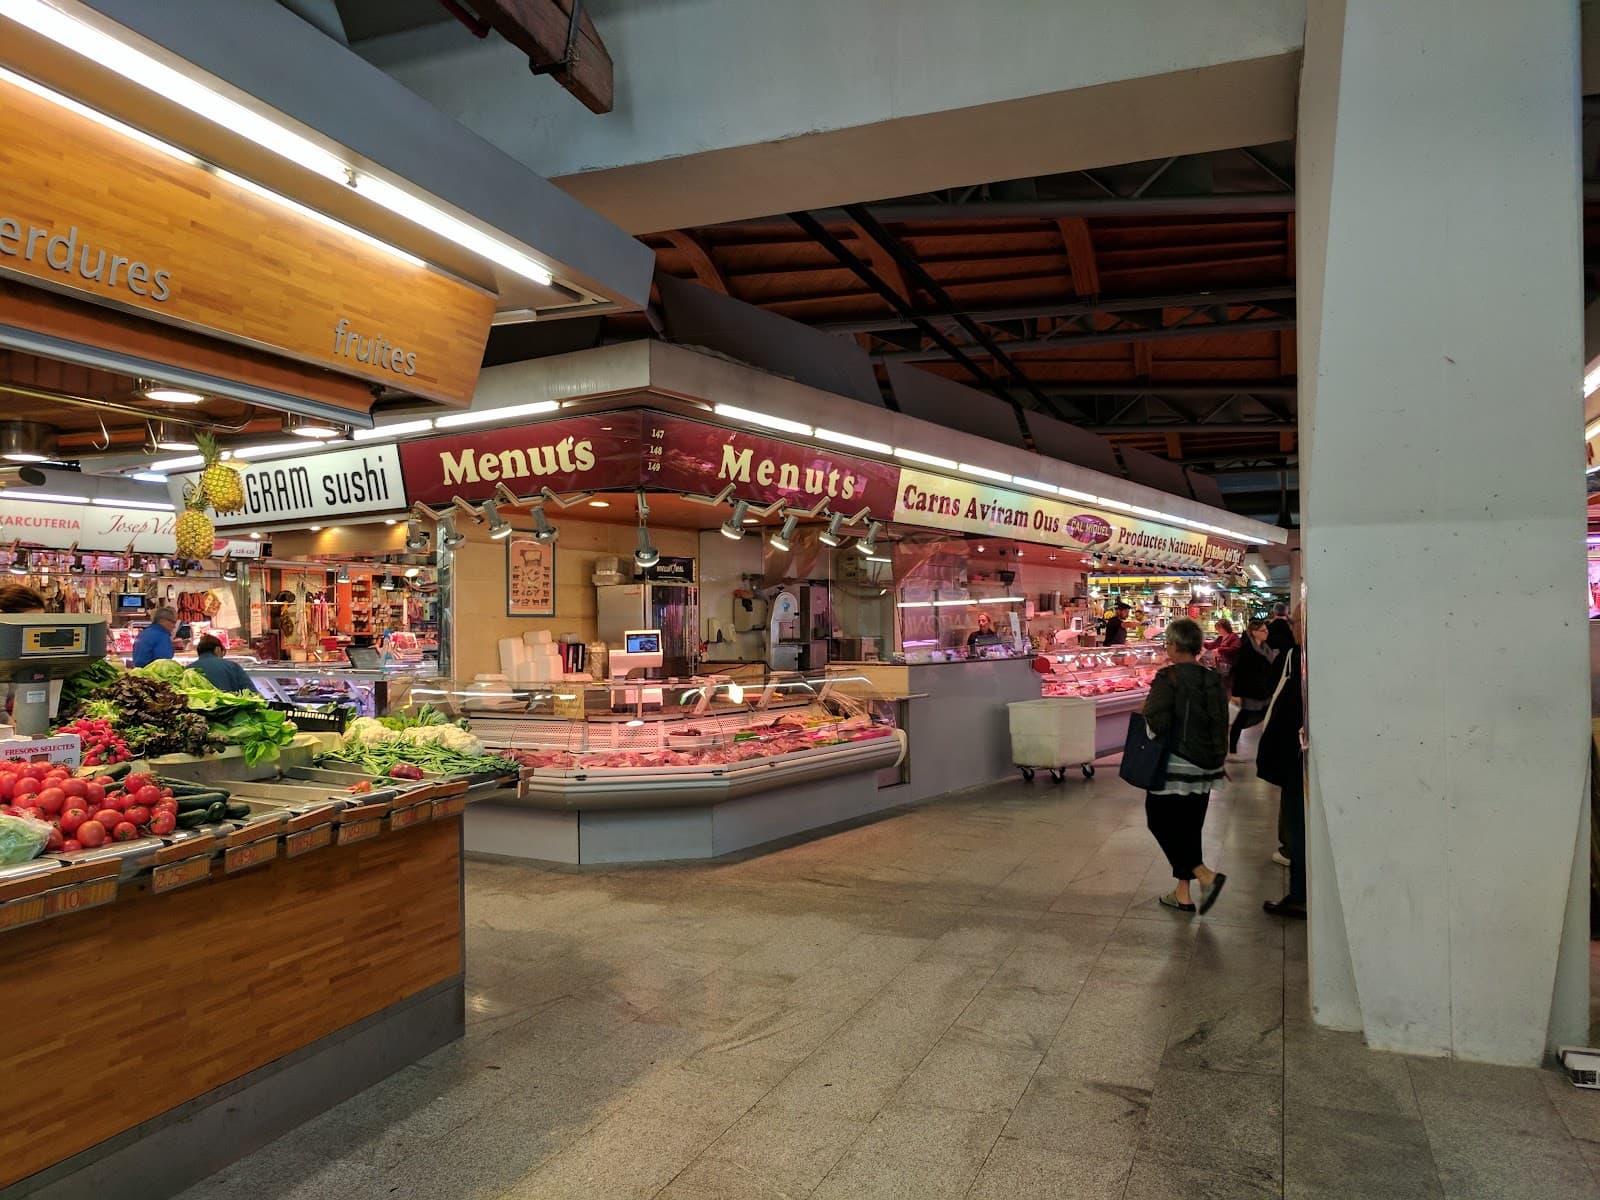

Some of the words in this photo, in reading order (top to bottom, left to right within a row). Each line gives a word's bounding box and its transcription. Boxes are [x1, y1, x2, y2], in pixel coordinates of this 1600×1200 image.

[333, 318, 417, 376] fruites
[651, 428, 665, 439] 147
[649, 445, 663, 456] 148
[323, 456, 389, 506] sushi
[647, 462, 661, 472] 149
[717, 444, 855, 500] Menuts
[903, 484, 961, 517] Carns
[964, 496, 1029, 529] Aviram
[1033, 509, 1060, 533] Ous
[98, 514, 150, 545] Josep
[1118, 527, 1167, 551] Productes
[1169, 537, 1204, 558] Naturals
[5, 747, 39, 756] FRESONS
